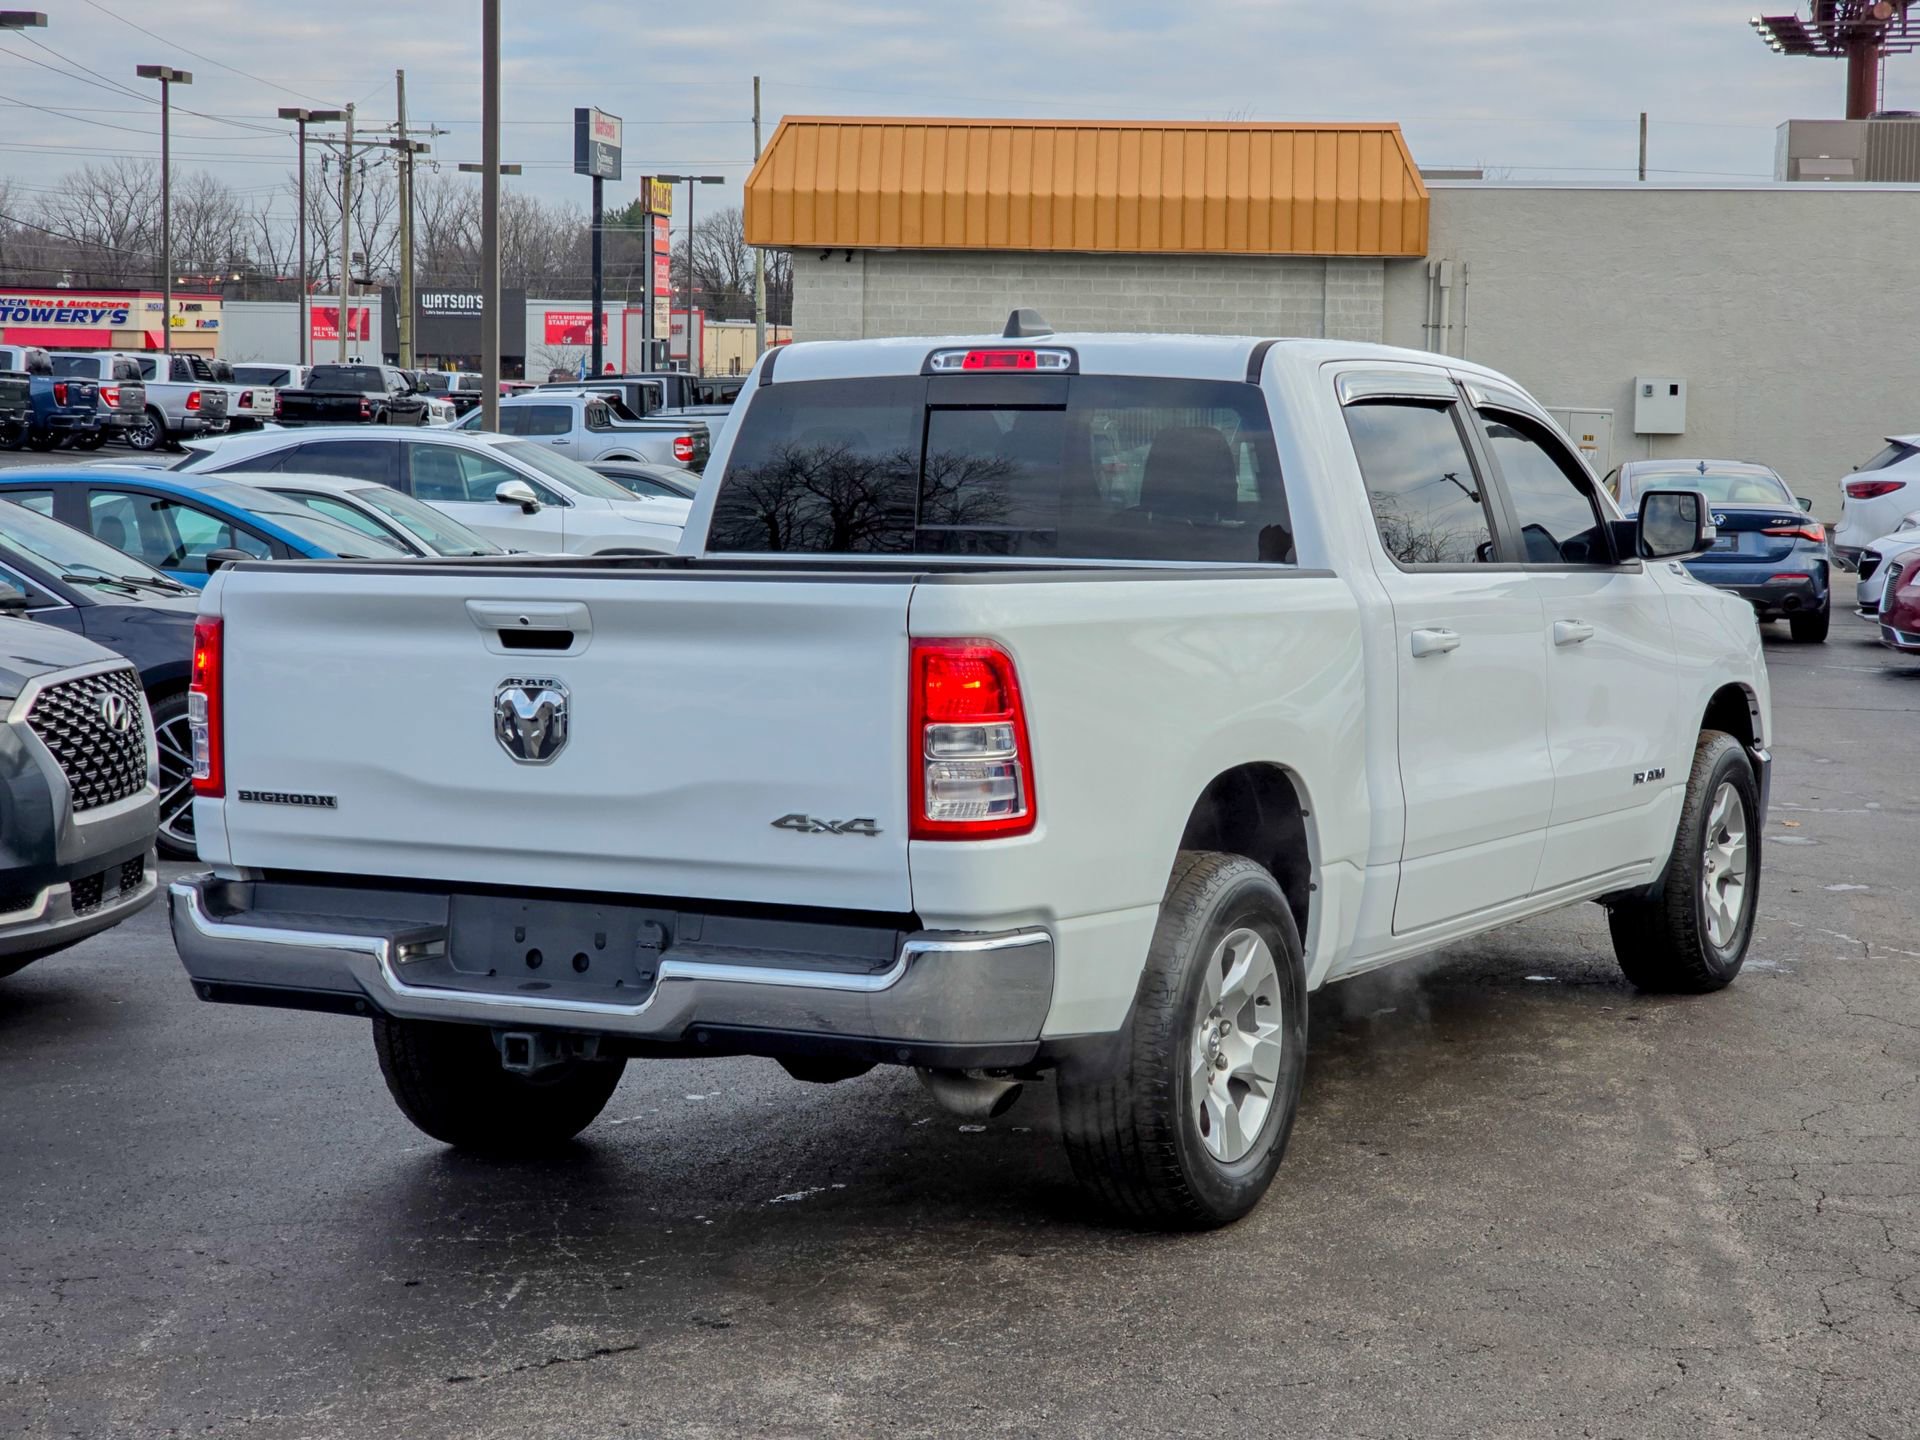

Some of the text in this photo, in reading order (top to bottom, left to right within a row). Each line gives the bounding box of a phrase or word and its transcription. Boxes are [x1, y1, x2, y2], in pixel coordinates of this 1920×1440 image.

[28, 299, 54, 307] Tire
[422, 294, 483, 309] WATSON'S
[0, 307, 129, 324] TOWERY'S
[510, 679, 553, 687] RAM
[1632, 767, 1665, 786] RAM
[237, 789, 337, 808] BIGHORN
